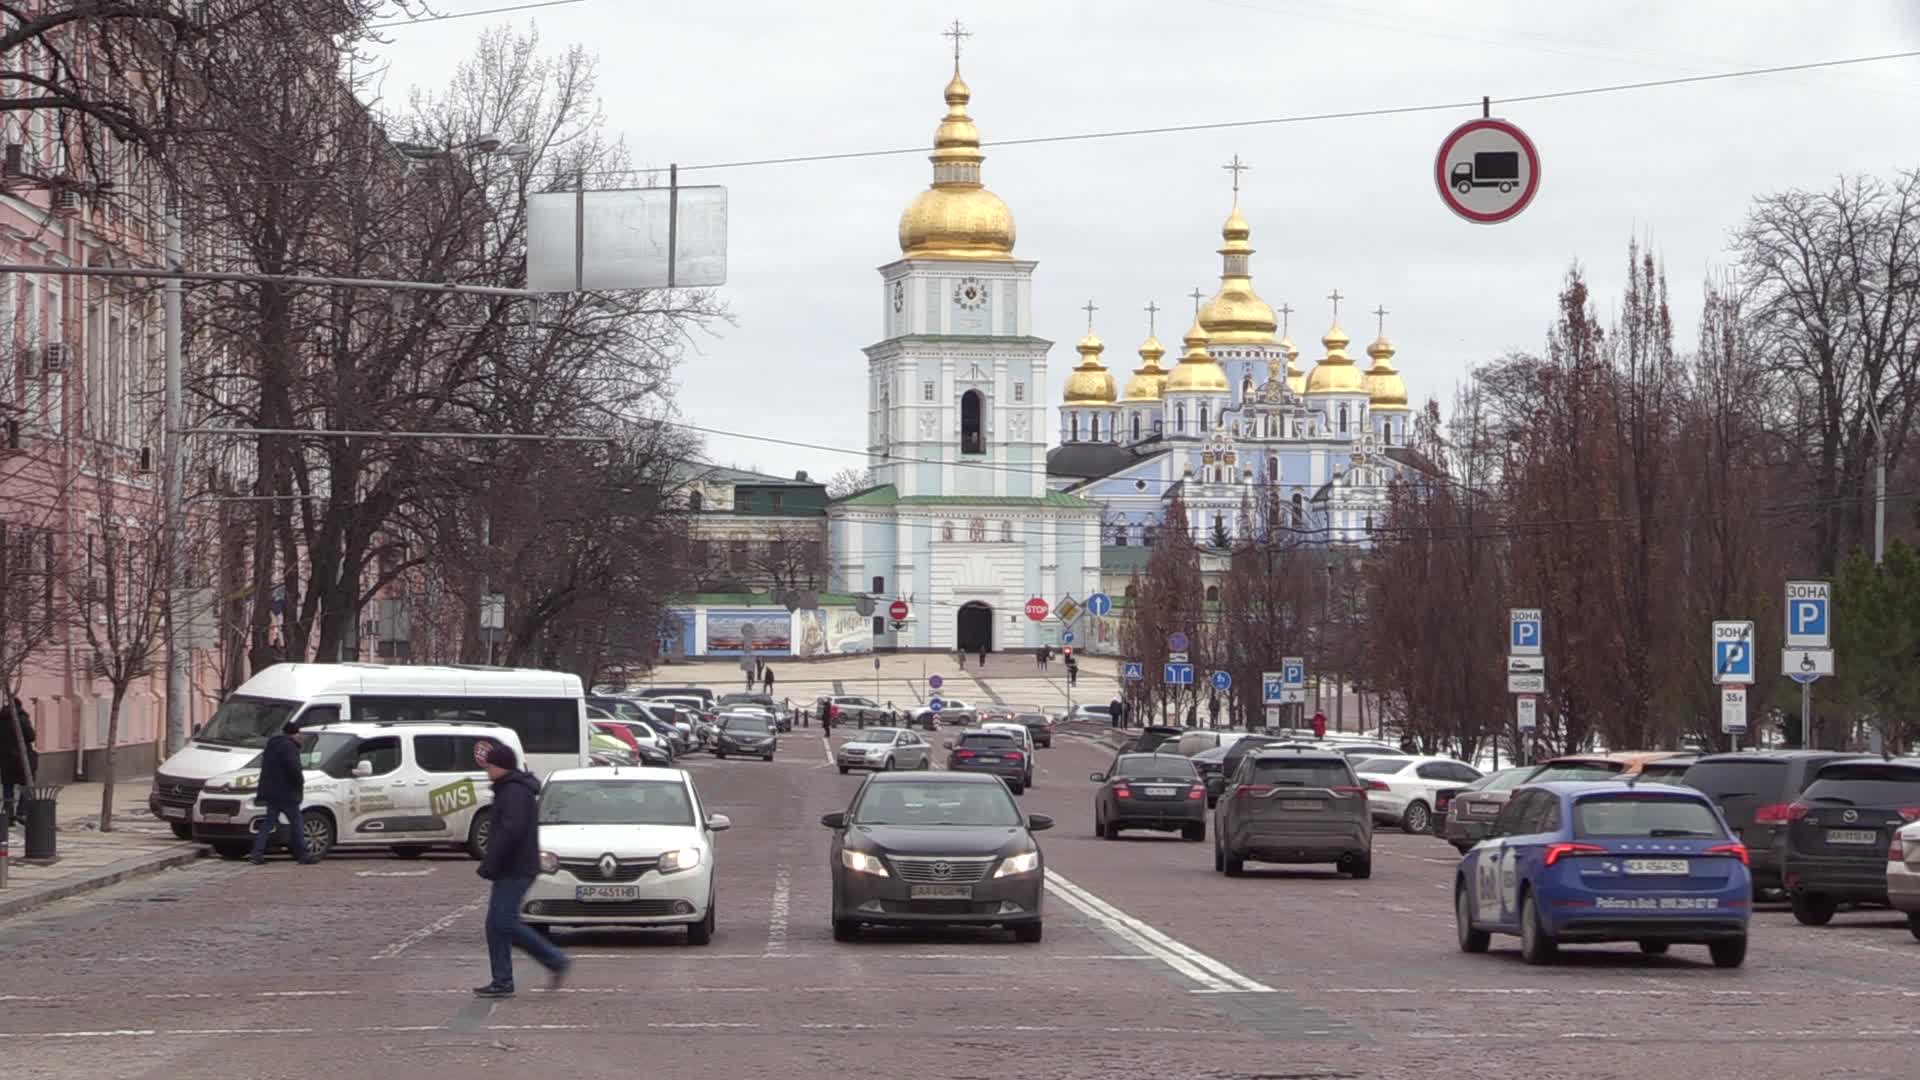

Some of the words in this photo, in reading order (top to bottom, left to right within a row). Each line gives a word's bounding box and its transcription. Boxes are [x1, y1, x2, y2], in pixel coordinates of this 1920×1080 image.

[1788, 586, 1828, 598] ЗОНА
[1026, 605, 1048, 614] STOP
[1799, 603, 1819, 632] P
[1519, 623, 1534, 645] P
[435, 786, 470, 814] IWS
